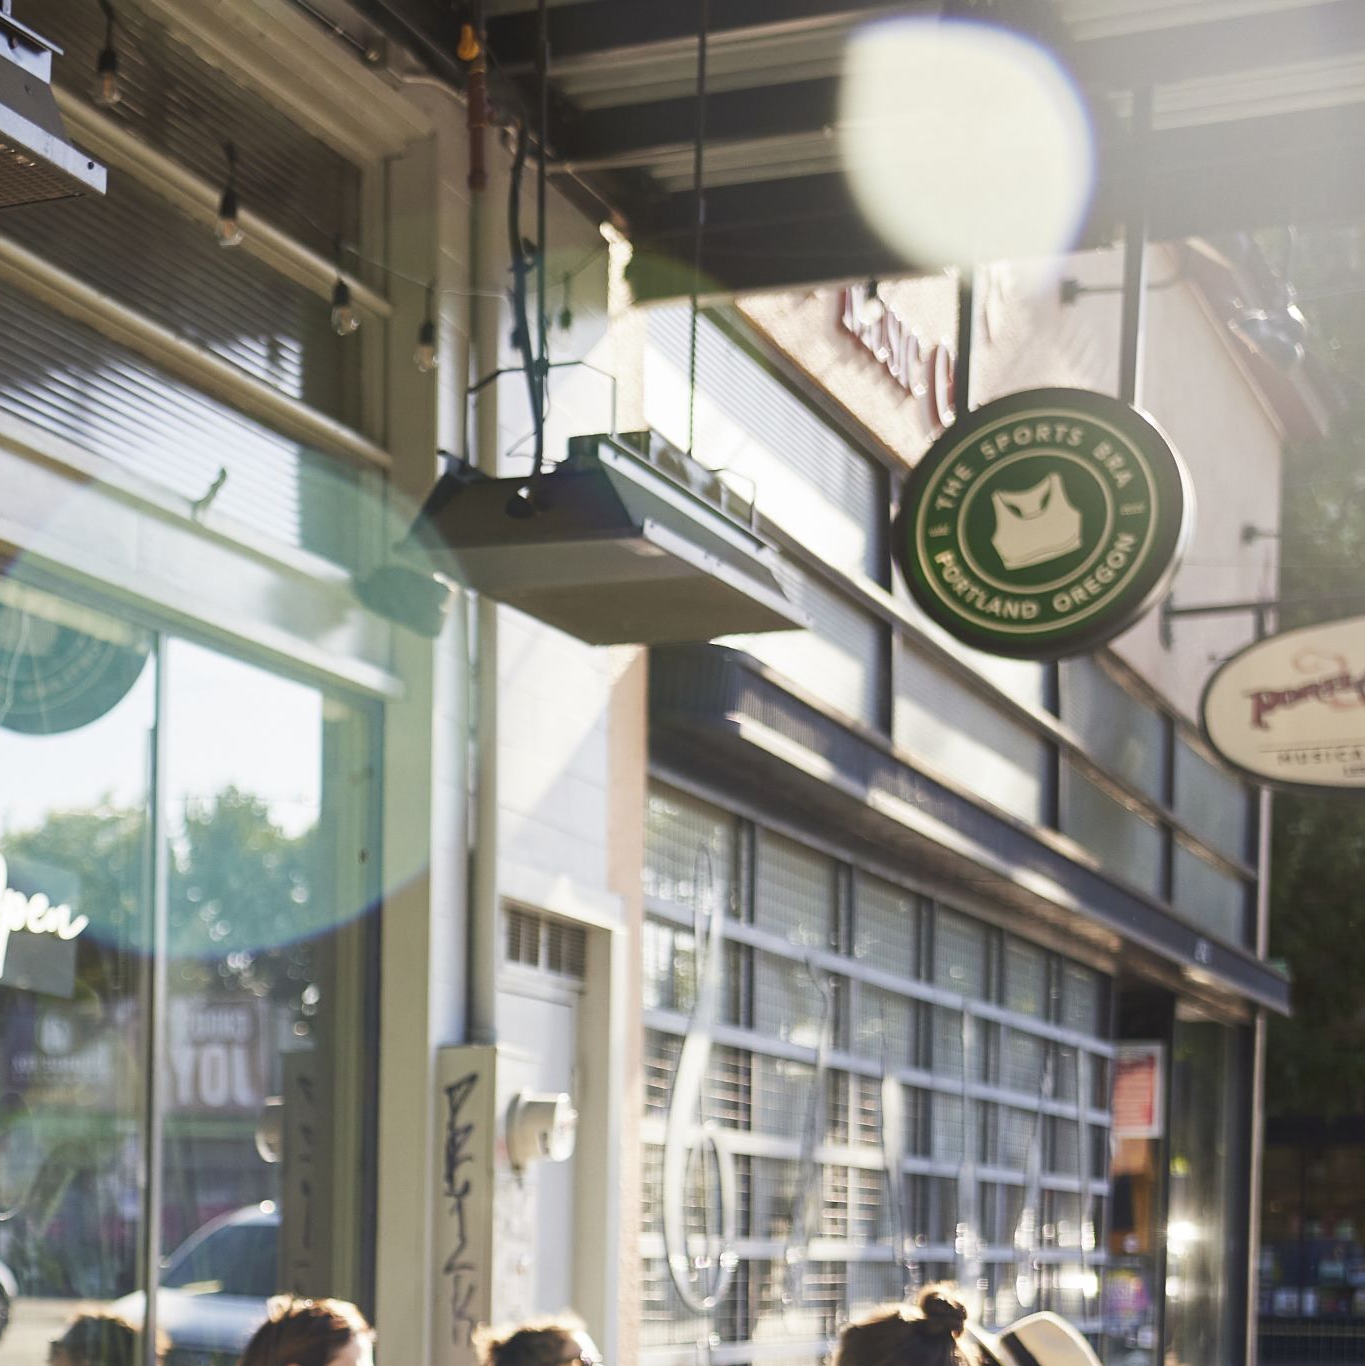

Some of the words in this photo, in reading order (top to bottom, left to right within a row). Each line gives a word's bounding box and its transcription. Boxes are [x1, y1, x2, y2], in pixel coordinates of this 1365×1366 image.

[935, 462, 974, 511] THE
[980, 423, 1084, 461] SPORTS
[1092, 441, 1133, 488] BRA
[934, 549, 1039, 620] PORTLAND
[1052, 533, 1136, 613] OREGON
